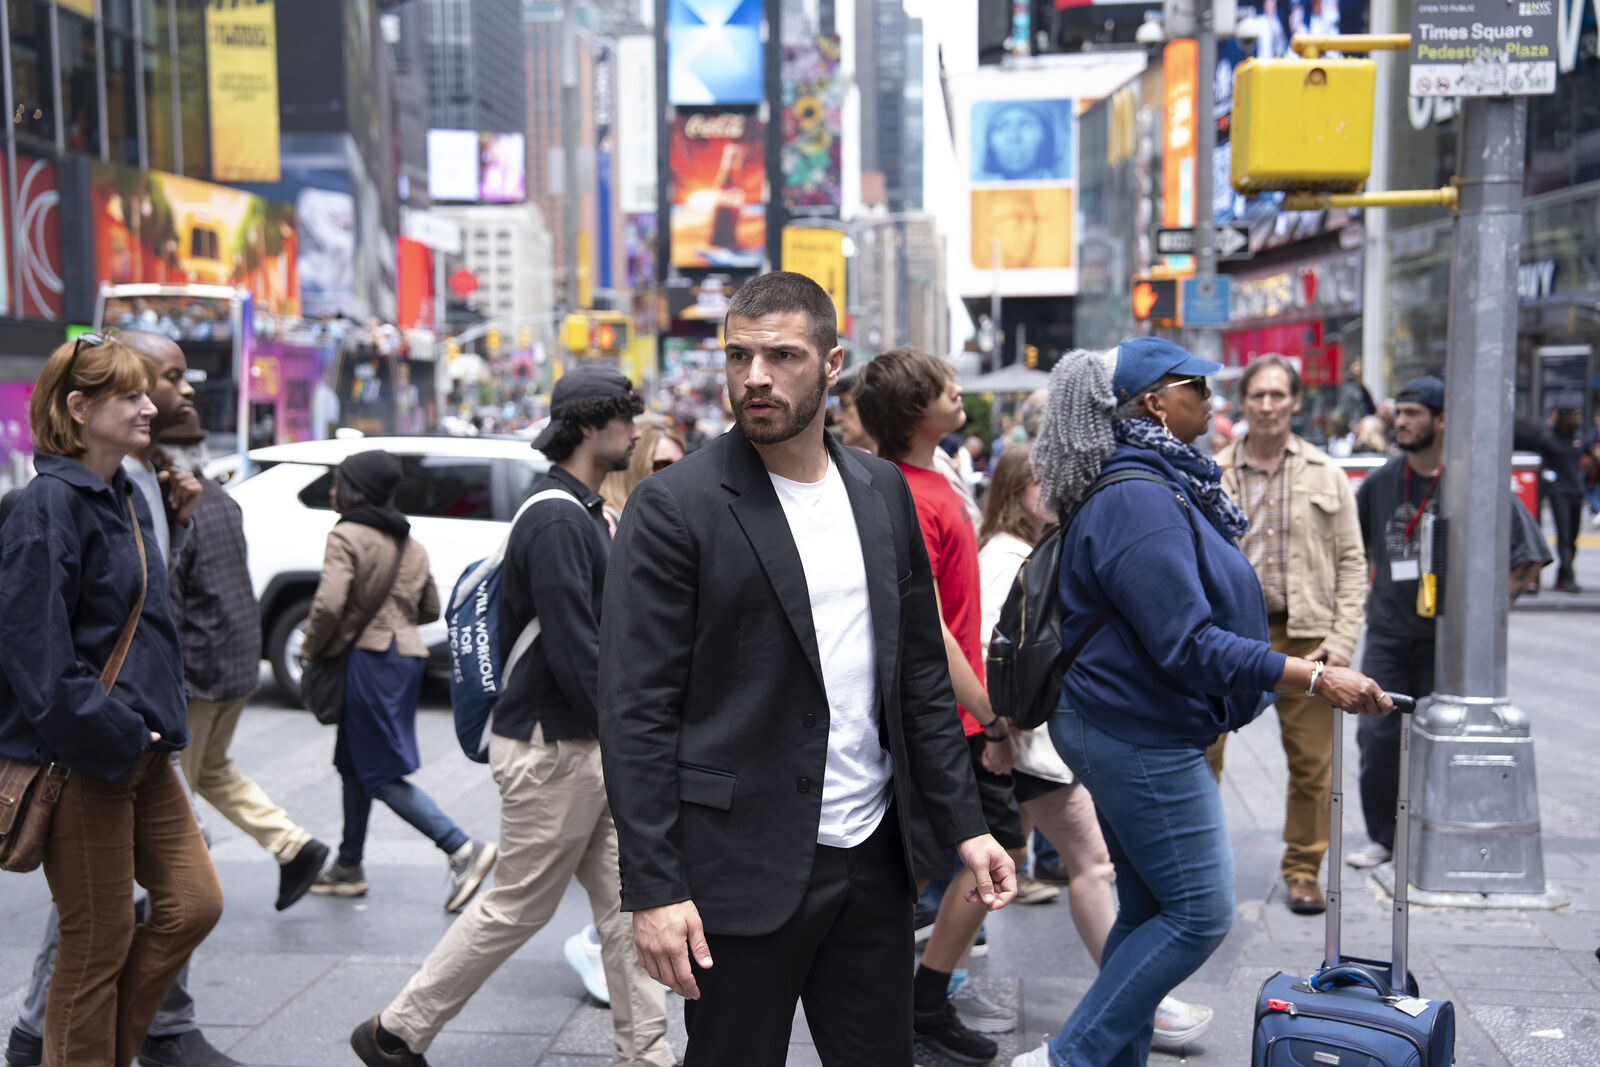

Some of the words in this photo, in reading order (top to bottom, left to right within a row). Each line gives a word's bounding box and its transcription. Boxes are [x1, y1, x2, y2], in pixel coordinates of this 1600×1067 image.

[1418, 23, 1469, 40] Times
[1471, 22, 1534, 42] Square
[1505, 42, 1549, 57] Plaza
[475, 579, 488, 616] WILL
[461, 625, 473, 656] FOR
[475, 616, 497, 693] WORKOUT
